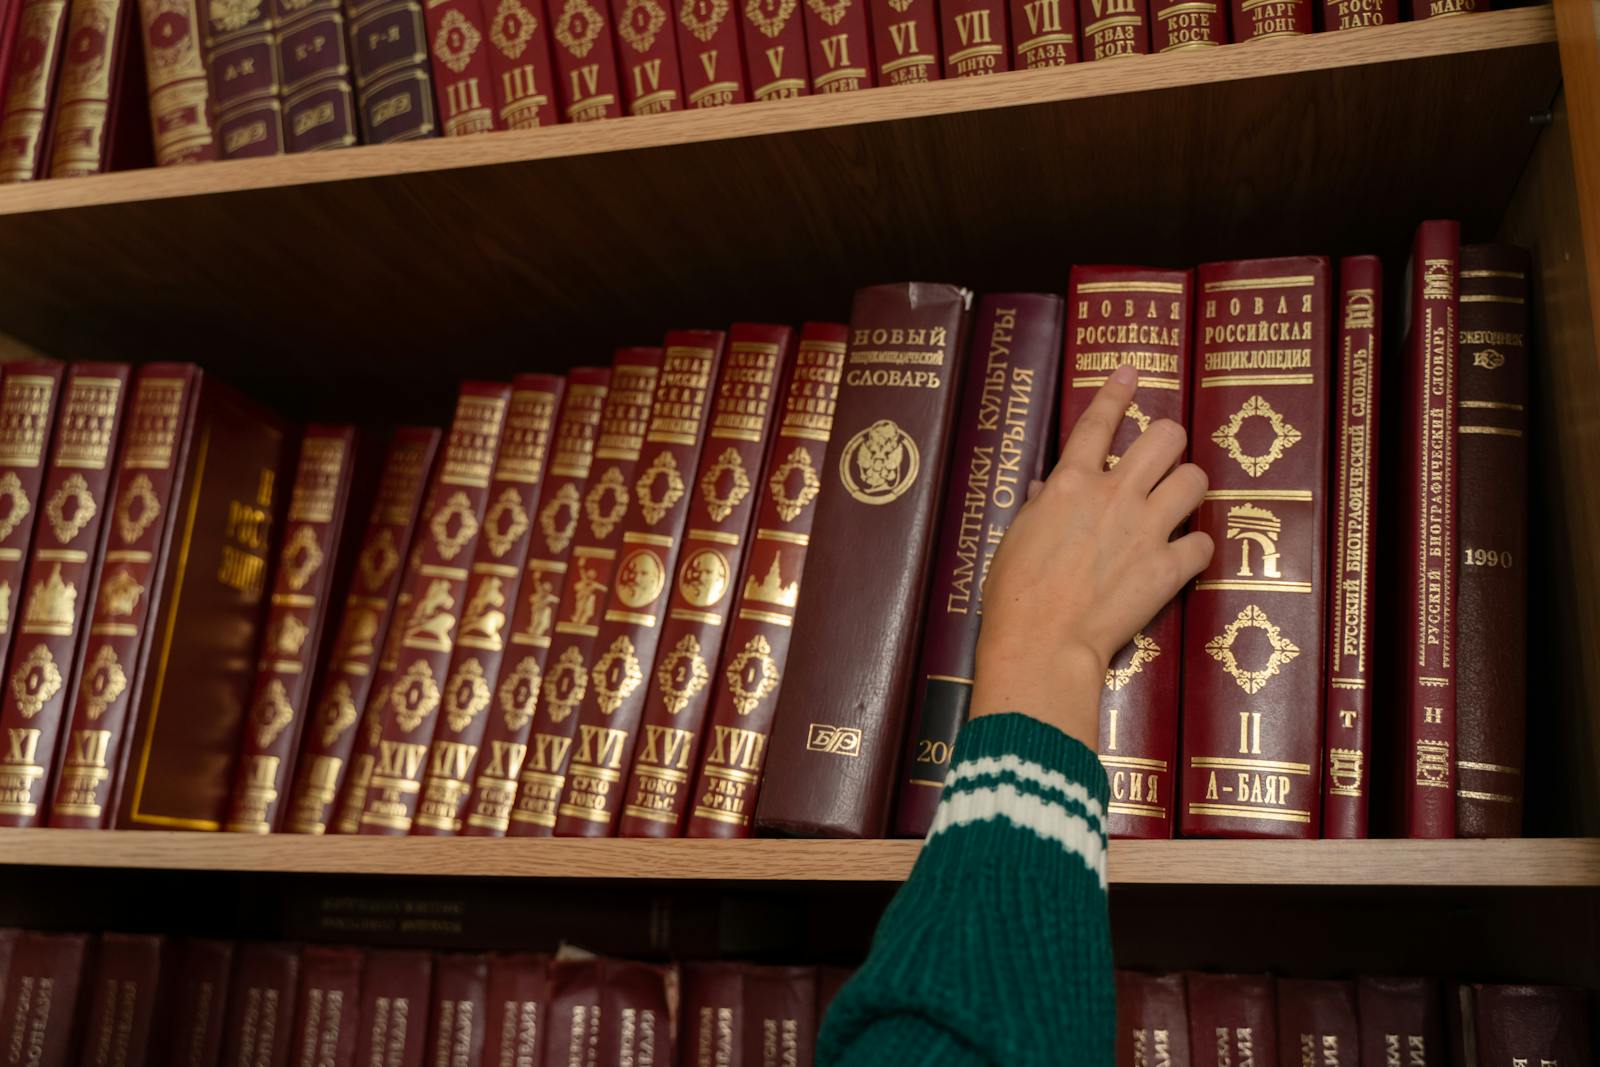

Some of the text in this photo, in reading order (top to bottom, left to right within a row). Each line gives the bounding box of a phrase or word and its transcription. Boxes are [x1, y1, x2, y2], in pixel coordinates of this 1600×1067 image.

[1023, 0, 1063, 35] VII
[1167, 13, 1211, 32] КОГЕ
[1251, 3, 1296, 21] ЛАРГ
[1338, 12, 1384, 30] ЛАГО
[888, 20, 920, 55] VI
[954, 9, 992, 46] VII
[1094, 25, 1136, 46] КВАЗ
[1168, 27, 1212, 47] КОСТ
[1252, 18, 1297, 36] ЛОНГ
[766, 46, 784, 78] V
[820, 33, 850, 69] VI
[1026, 44, 1067, 64] КАЗА
[633, 59, 662, 97] IV
[700, 50, 718, 82] V
[502, 64, 538, 101] III
[570, 64, 599, 101] IV
[447, 78, 480, 116] III
[1078, 300, 1181, 319] НОВАЯ
[1206, 294, 1313, 318] НОВАЯ
[853, 326, 947, 347] НОВЫЙ
[1076, 323, 1180, 346] РОССИЙСКАЯ
[1204, 321, 1313, 345] РОССИЙСКАЯ
[1075, 351, 1179, 373] ЭНЦИКЛОПЕДИЯ
[1204, 349, 1312, 371] ЭНЦИКЛОПЕДИЯ
[847, 369, 941, 389] СЛОВАРЬ
[993, 367, 1034, 508] ОТКРЫТИЯ
[947, 446, 995, 615] ПАМЯТНИКИ
[977, 308, 1016, 431] КУЛЬТУРЫ
[1427, 327, 1445, 645] РУССКИЙ БИОГРАФИЧЕСКИЙ СЛОВАРЬ
[1343, 348, 1368, 656] РУССКИЙ БИОГРАФИЧЕСКИЙ СЛОВАРЬ
[1464, 549, 1512, 568] 1990
[611, 668, 620, 683] 1
[675, 666, 687, 682] 2
[747, 668, 755, 683] 1
[1339, 710, 1357, 728] Т
[1423, 707, 1443, 724] Н
[1108, 709, 1119, 750] I
[1239, 712, 1262, 754] II
[527, 733, 573, 773] XV
[572, 724, 629, 769] XVI
[638, 724, 696, 769] XVI
[707, 725, 767, 772] XVII
[917, 740, 955, 765] 20
[374, 740, 428, 780] XIV
[483, 740, 527, 780] XV
[572, 776, 610, 794] СУХО
[639, 776, 678, 795] ТОКО
[708, 777, 747, 797] УЛЬТ
[1113, 771, 1159, 803] СИЯ
[569, 790, 607, 810] ТОКО
[635, 792, 674, 812] УЛЬС
[703, 795, 744, 813] ФРАН
[638, 1010, 656, 1067] ЕДИЯ
[714, 1008, 733, 1067] ЕДИЯ
